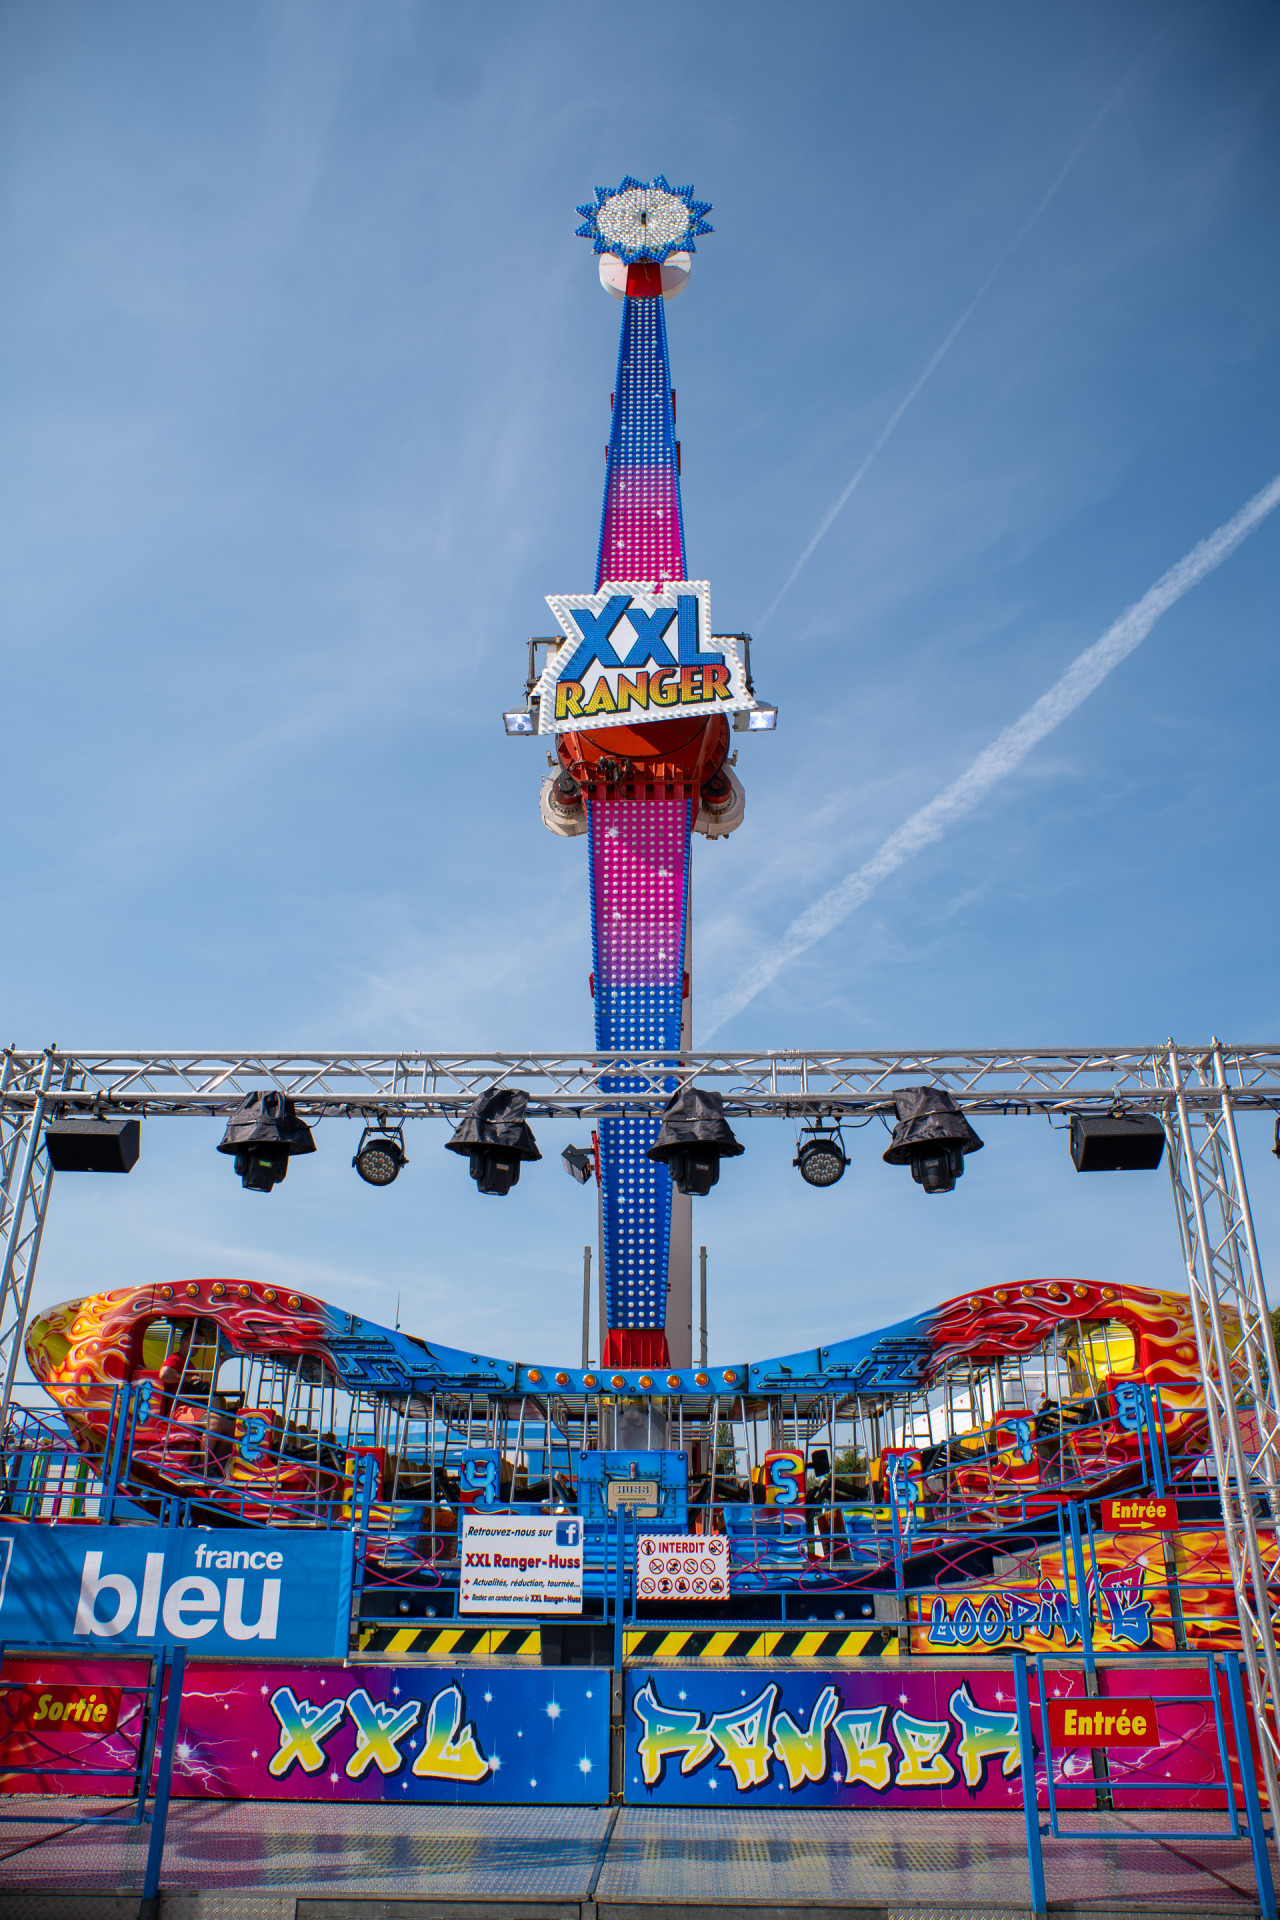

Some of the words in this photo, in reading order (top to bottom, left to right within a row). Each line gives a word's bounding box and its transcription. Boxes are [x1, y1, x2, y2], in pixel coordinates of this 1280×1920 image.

[557, 594, 725, 682] XXL
[555, 663, 735, 720] RANGER
[616, 1485, 649, 1494] HUSS
[1111, 1500, 1167, 1519] Entrée
[467, 1525, 536, 1537] Retrouvez-nous
[537, 1529, 553, 1537] sur
[194, 1544, 284, 1570] france
[465, 1552, 491, 1568] XXL
[658, 1542, 705, 1553] INTERDIT
[73, 1551, 282, 1640] bleu
[472, 1577, 508, 1587] Actualités,
[510, 1578, 545, 1588] réduction,
[530, 1594, 542, 1603] XXL
[33, 1692, 109, 1725] Sortie
[268, 1684, 490, 1781] XXL
[632, 1676, 1036, 1794] RANGER
[1064, 1707, 1148, 1739] Entrée
